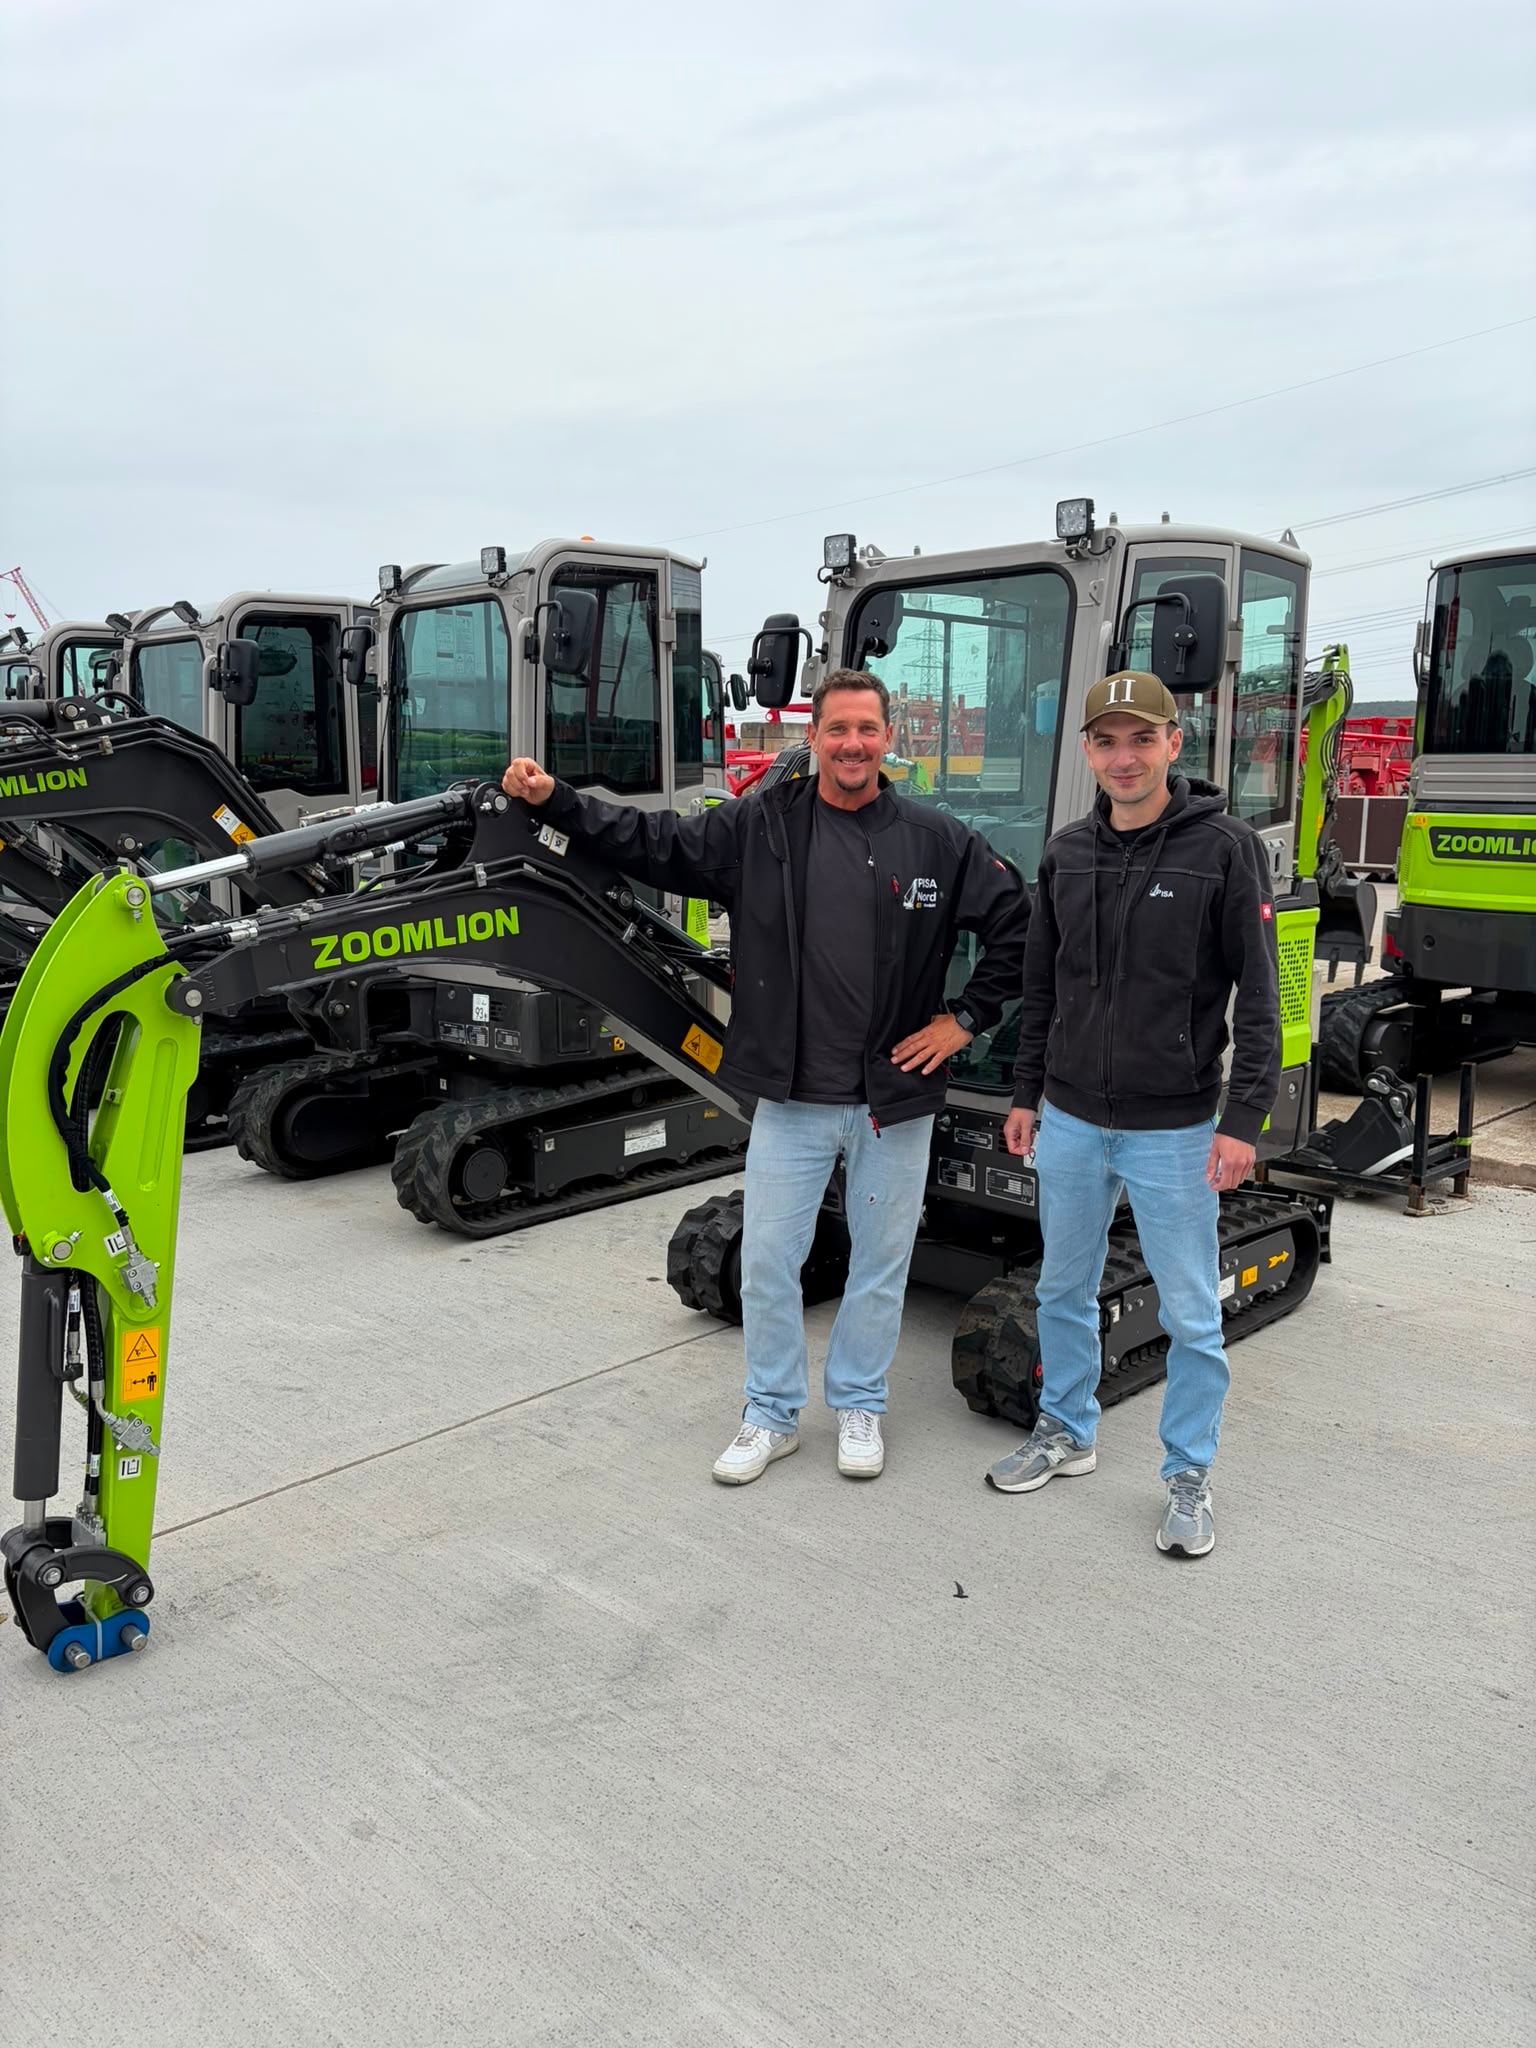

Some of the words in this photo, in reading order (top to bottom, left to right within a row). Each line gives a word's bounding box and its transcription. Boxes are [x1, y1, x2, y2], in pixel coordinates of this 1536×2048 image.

[0, 767, 88, 797] MLION
[1437, 834, 1536, 855] ZOOMLI
[917, 891, 937, 902] Nord
[311, 906, 520, 969] ZOOMLION
[475, 1006, 484, 1019] 93
